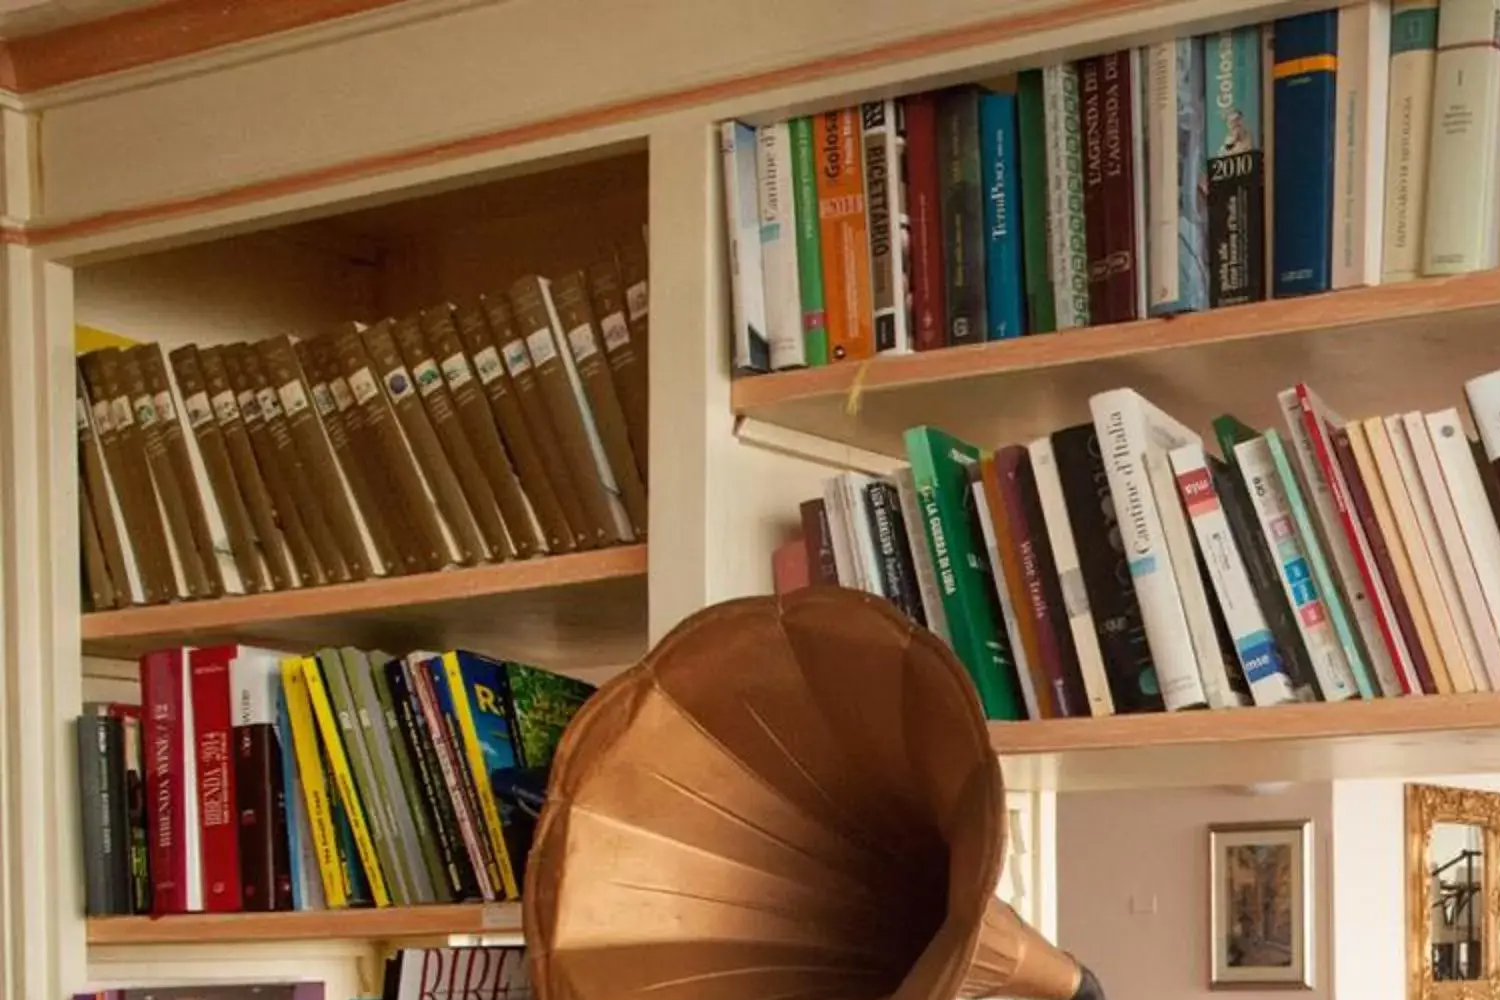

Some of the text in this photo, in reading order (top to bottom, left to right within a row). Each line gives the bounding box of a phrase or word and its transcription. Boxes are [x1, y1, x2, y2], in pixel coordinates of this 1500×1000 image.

[1105, 83, 1121, 177] L'AGENDA
[1211, 154, 1254, 182] 2010
[868, 145, 889, 257] RICETTARIO
[1109, 410, 1151, 556] Cantine d'Italia
[157, 734, 171, 777] WINE
